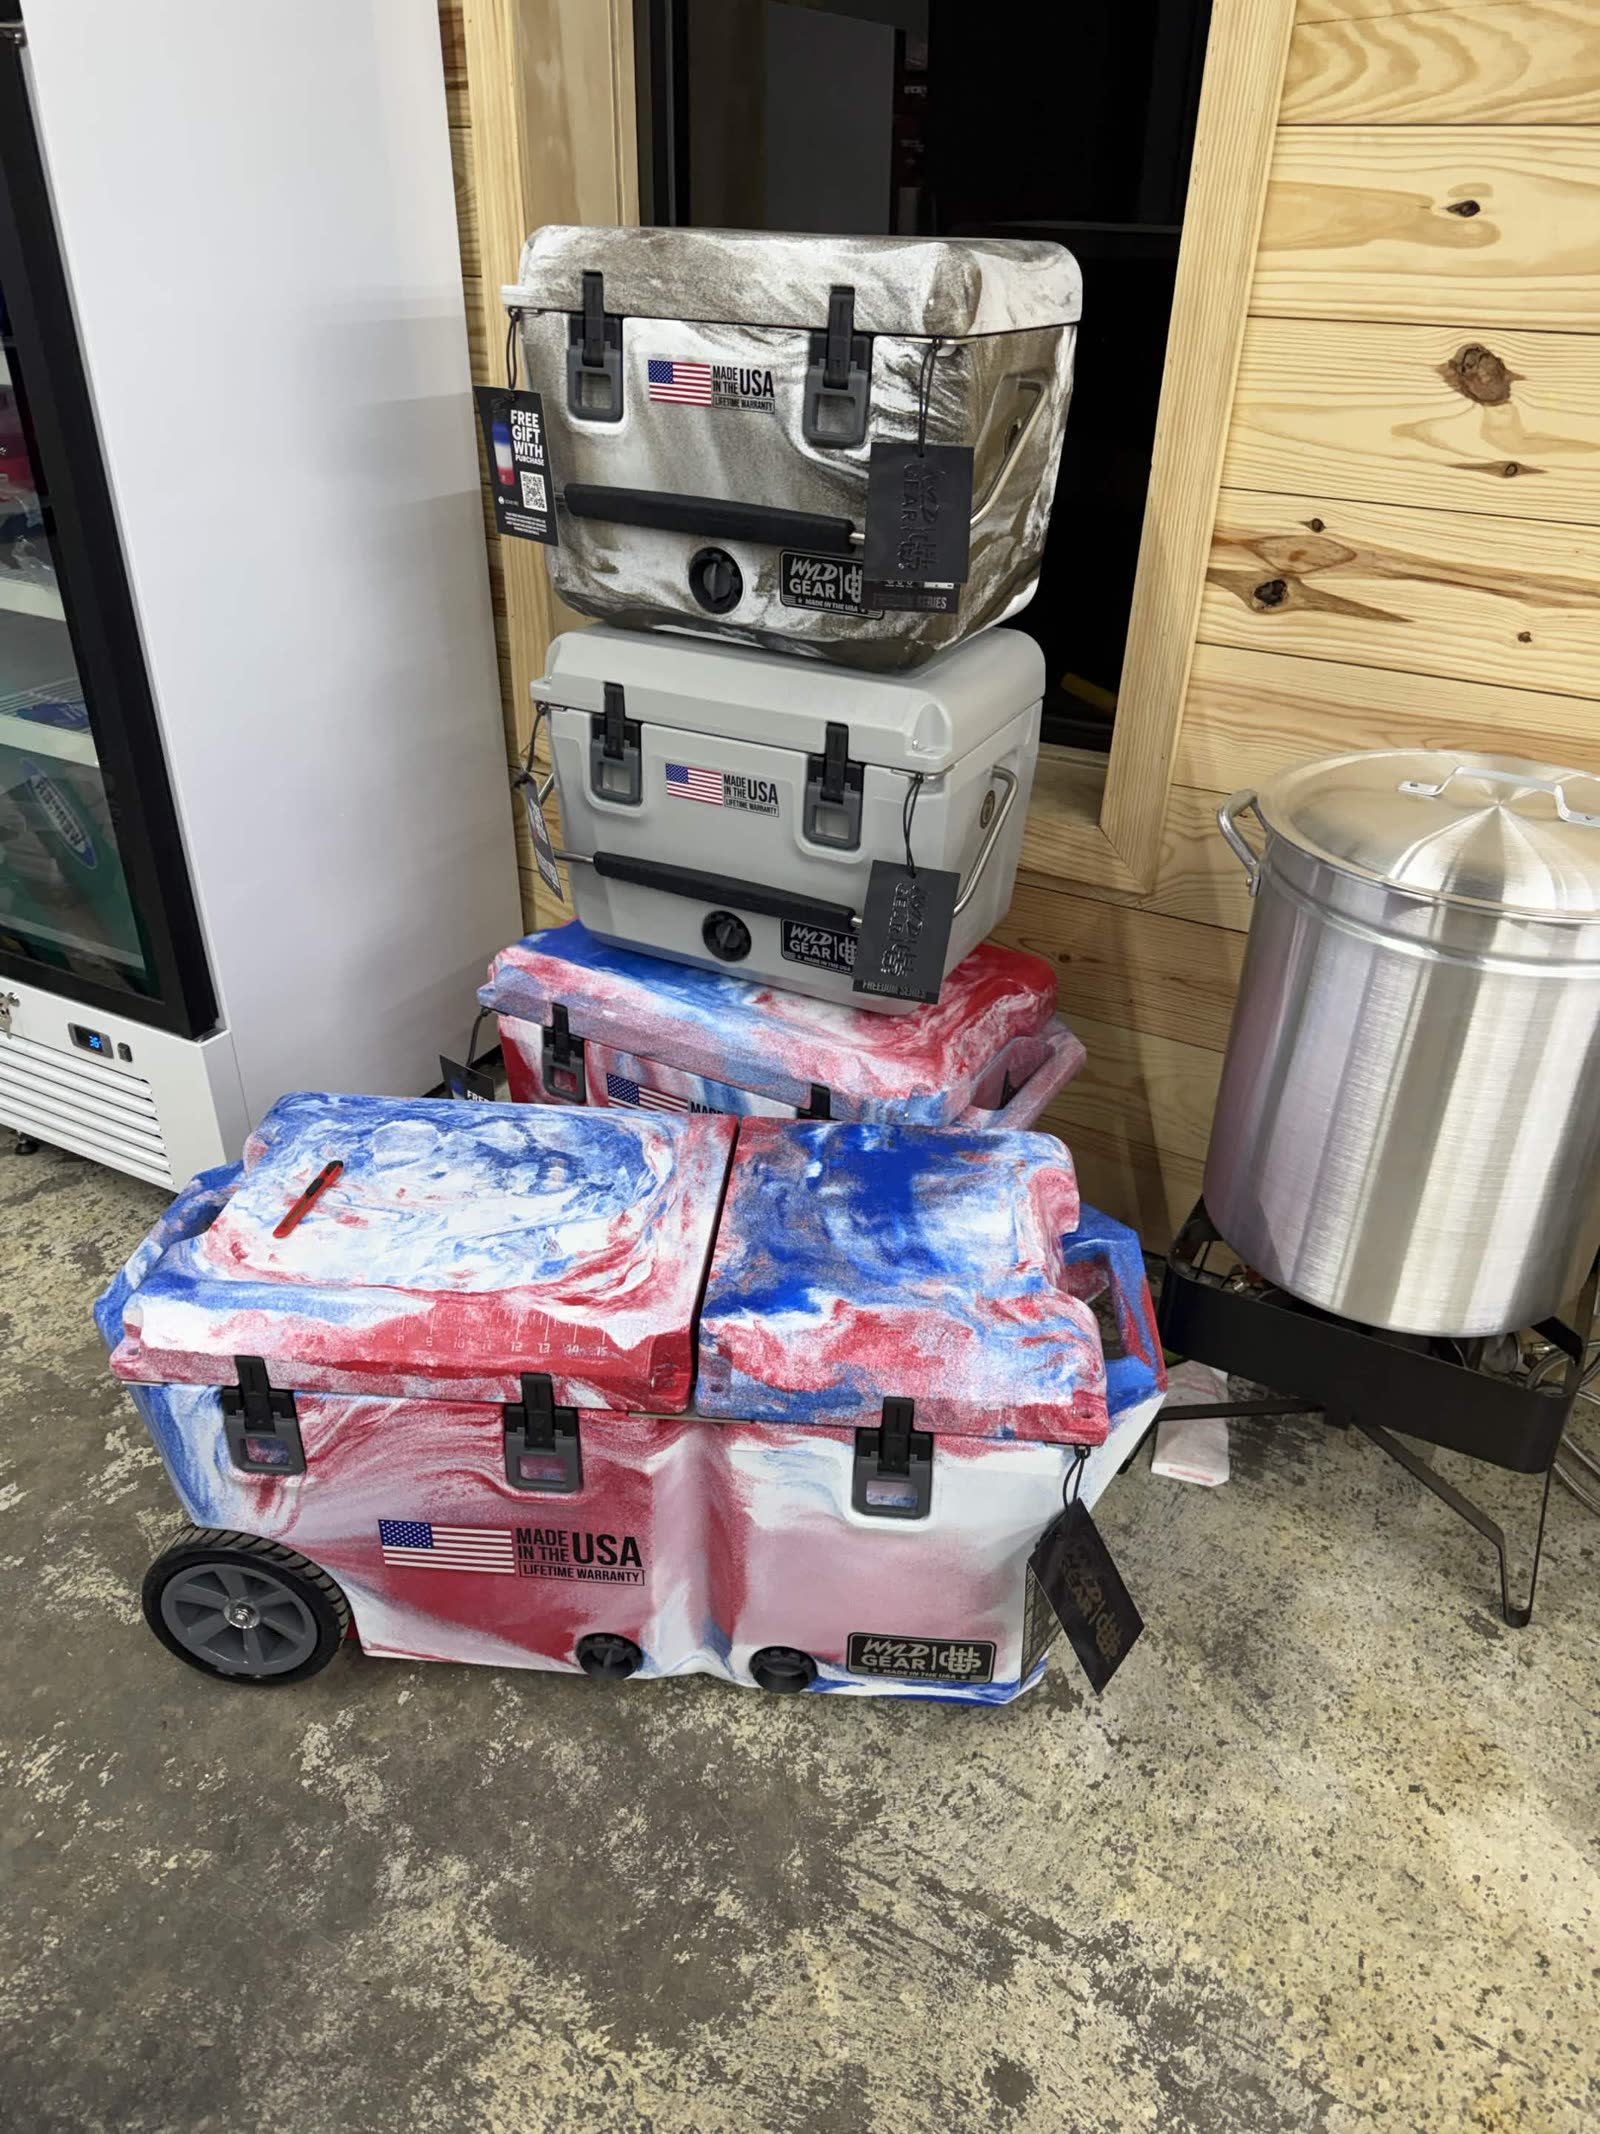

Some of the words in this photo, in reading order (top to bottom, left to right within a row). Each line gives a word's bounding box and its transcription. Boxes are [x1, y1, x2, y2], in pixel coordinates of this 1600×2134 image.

[713, 366, 738, 380] MADE
[713, 381, 722, 392] IN
[723, 381, 738, 394] THE
[739, 368, 775, 398] USA
[714, 395, 740, 408] LIFETIME
[741, 399, 773, 411] WARRANTY
[510, 409, 540, 428] FREE
[512, 424, 541, 444] GIFT
[513, 440, 544, 458] WITH
[515, 455, 545, 466] PURCHASE
[789, 557, 838, 581] WYLD
[789, 578, 836, 599] GEAR
[723, 773, 746, 788] MADE
[724, 786, 732, 796] IN
[733, 788, 747, 799] THE
[747, 778, 779, 805] USA
[725, 798, 748, 810] LIFETIME
[749, 802, 777, 815] WARRANTY
[789, 924, 833, 946] WYLD
[789, 940, 832, 961] GEAR
[690, 1100, 724, 1114] MA
[511, 1341, 523, 1352] 12
[538, 1343, 551, 1353] 13
[516, 1527, 568, 1547] MADE
[517, 1546, 533, 1560] IN
[539, 1547, 570, 1563] THE
[571, 1531, 643, 1568] USA
[523, 1563, 574, 1578] LIFETIME
[576, 1567, 641, 1583] WARRANTY
[863, 1638, 930, 1657] WYLD
[861, 1654, 927, 1671] GEAR
[883, 1668, 908, 1676] MADE
[938, 1672, 957, 1680] USA
